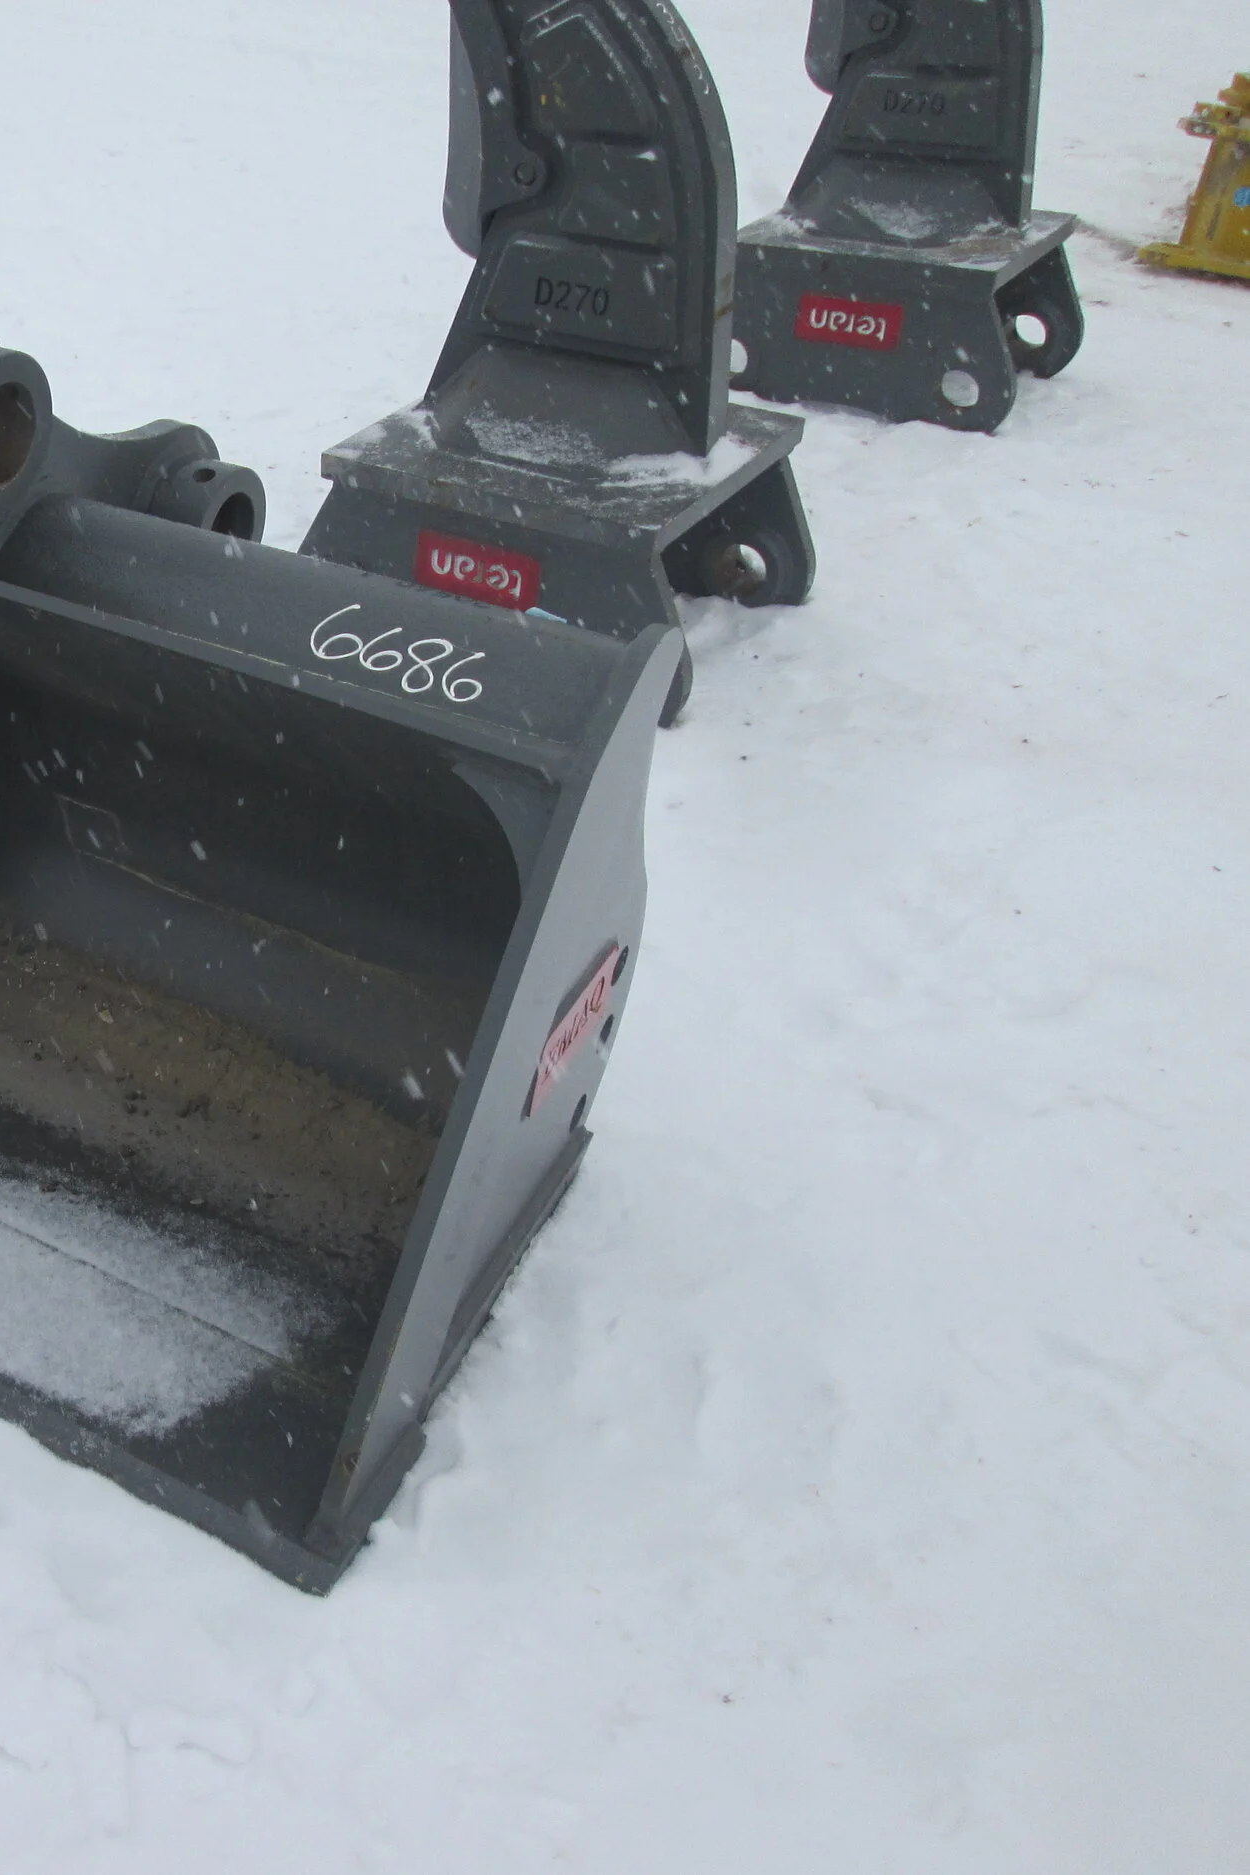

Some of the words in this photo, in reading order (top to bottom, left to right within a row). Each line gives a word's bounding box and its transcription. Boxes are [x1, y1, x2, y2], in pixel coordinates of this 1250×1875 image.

[883, 88, 947, 115] D270
[534, 276, 610, 316] D270
[809, 308, 887, 342] teran
[431, 549, 522, 601] teran
[311, 604, 485, 702] 6686
